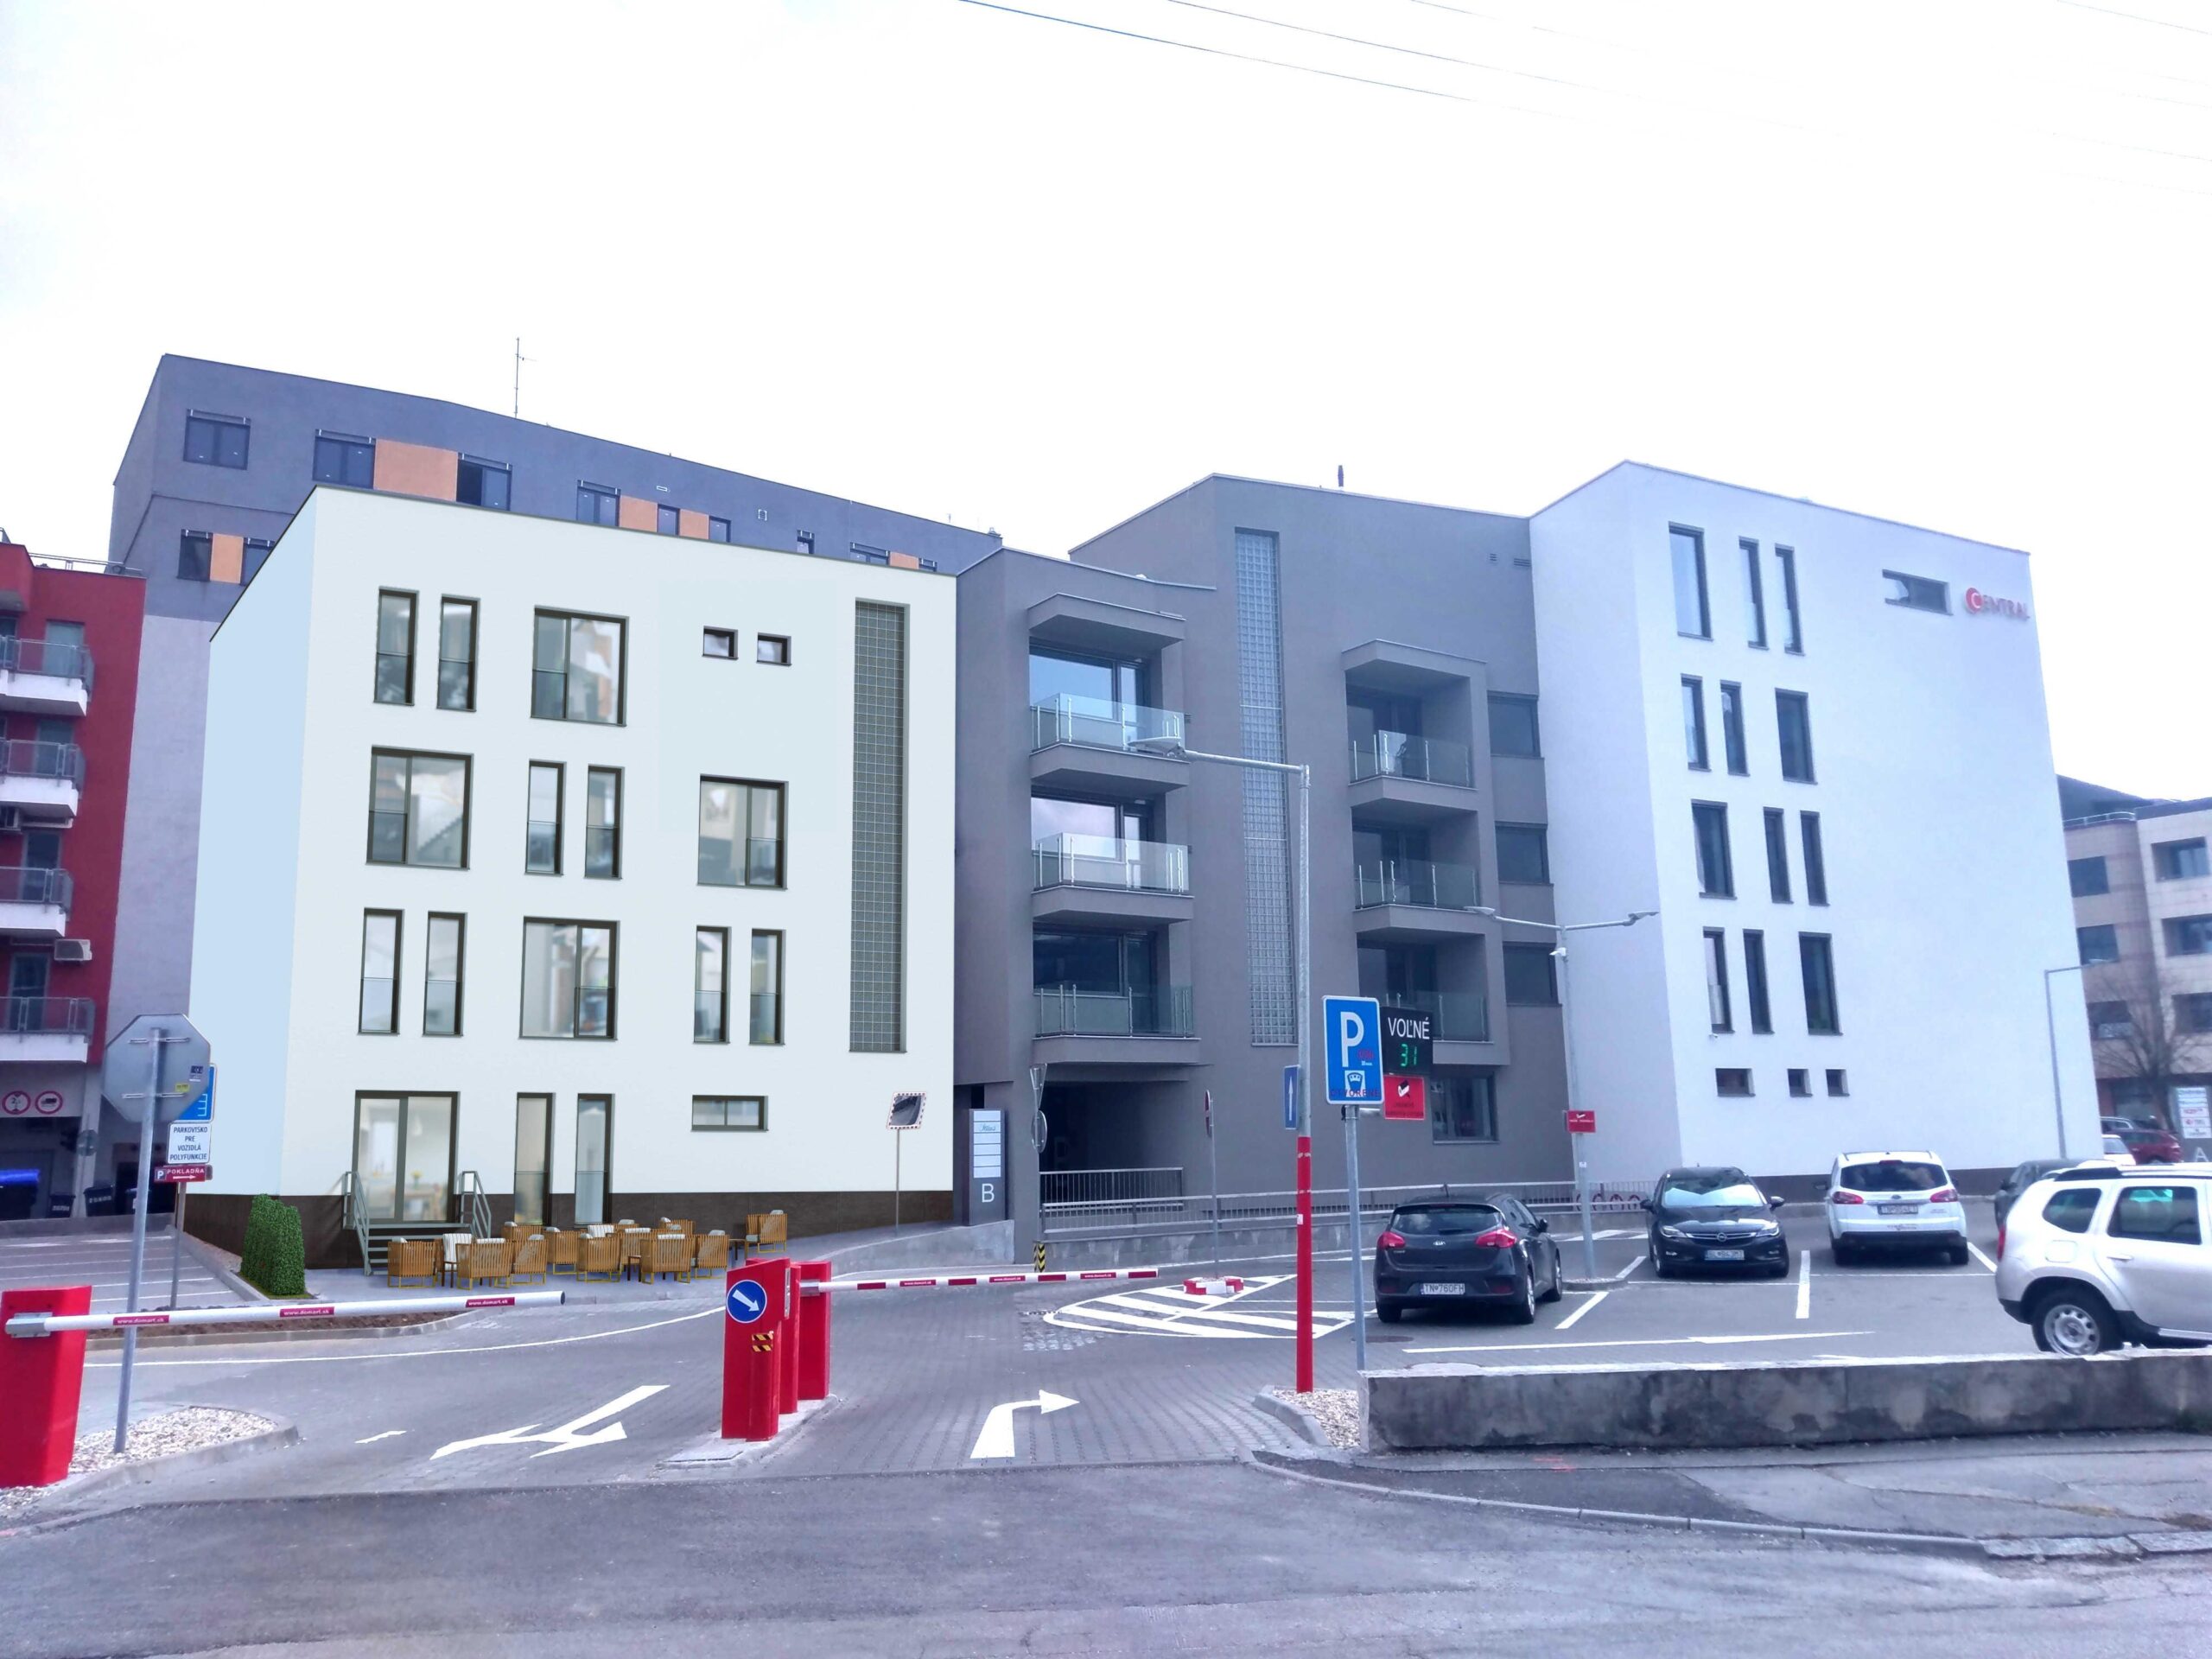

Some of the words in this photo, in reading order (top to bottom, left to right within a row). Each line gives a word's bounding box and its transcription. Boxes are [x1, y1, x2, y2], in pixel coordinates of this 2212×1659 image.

[1387, 1016, 1430, 1039] VOĽNÉ
[1340, 1011, 1364, 1067] P
[1401, 1043, 1417, 1067] 31
[169, 1153, 207, 1161] POLYFUNKCIE
[157, 1170, 164, 1179] P
[982, 1183, 995, 1203] B
